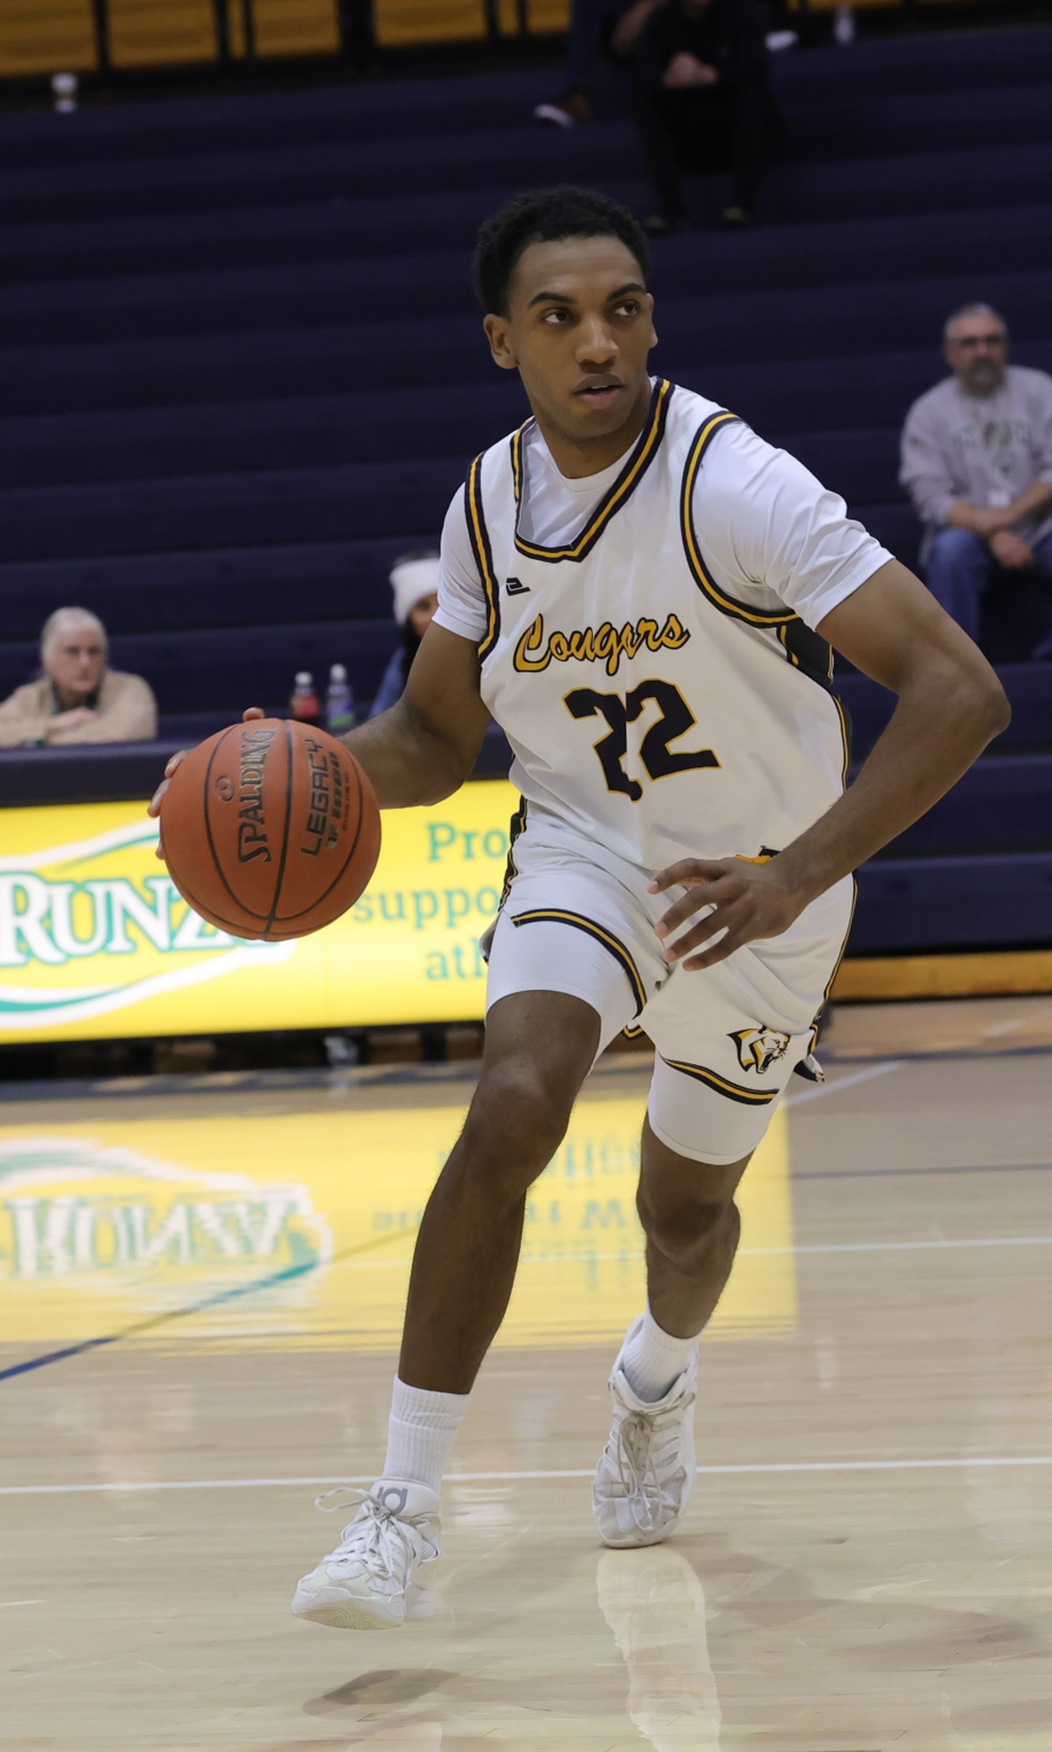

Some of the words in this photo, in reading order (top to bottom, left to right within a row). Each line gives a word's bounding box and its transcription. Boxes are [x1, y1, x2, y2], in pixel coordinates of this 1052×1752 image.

[513, 612, 691, 676] Cougars
[562, 678, 722, 803] 22
[238, 728, 278, 863] SPALDING
[301, 738, 331, 856] LEGACY
[427, 822, 508, 862] Pro
[0, 870, 283, 968] RUNZ
